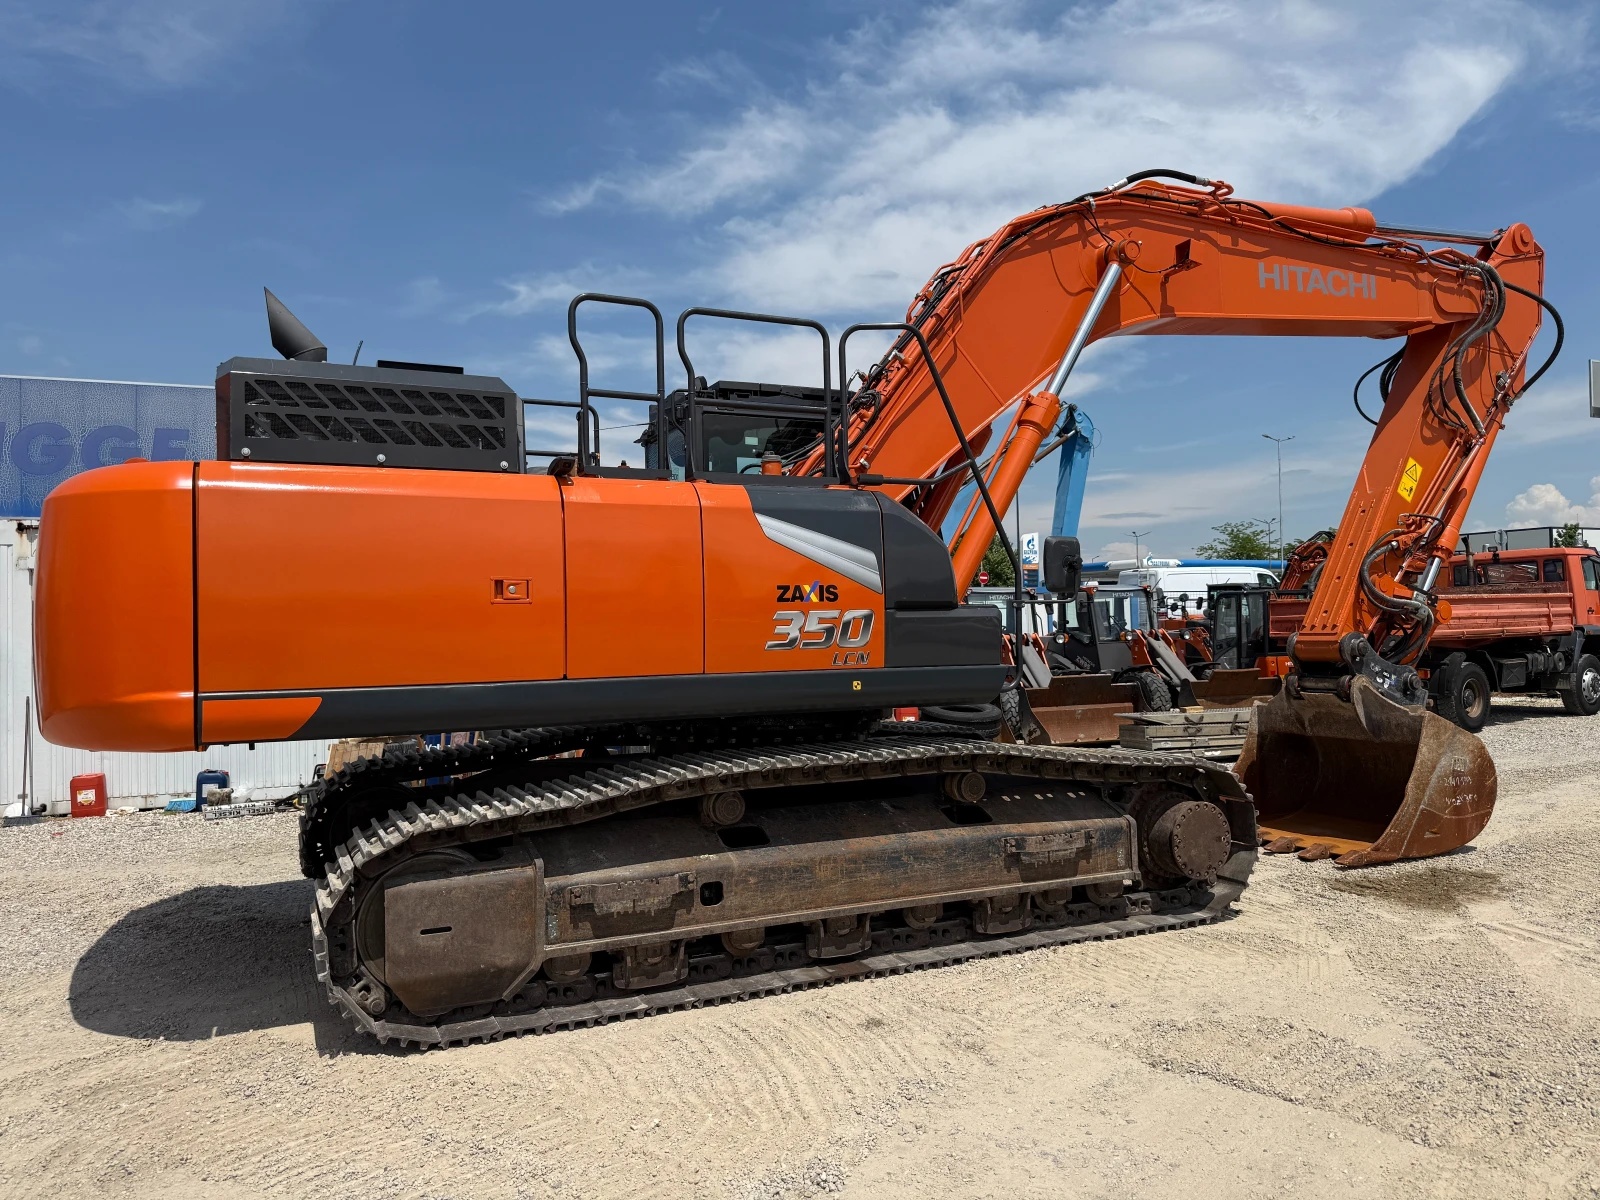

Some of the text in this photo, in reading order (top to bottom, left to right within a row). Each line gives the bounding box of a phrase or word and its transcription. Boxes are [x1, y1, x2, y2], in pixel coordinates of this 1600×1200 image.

[1257, 261, 1377, 300] HITACHI
[776, 580, 839, 603] ZAXIS
[765, 609, 875, 650] 350
[831, 651, 871, 666] LCN
